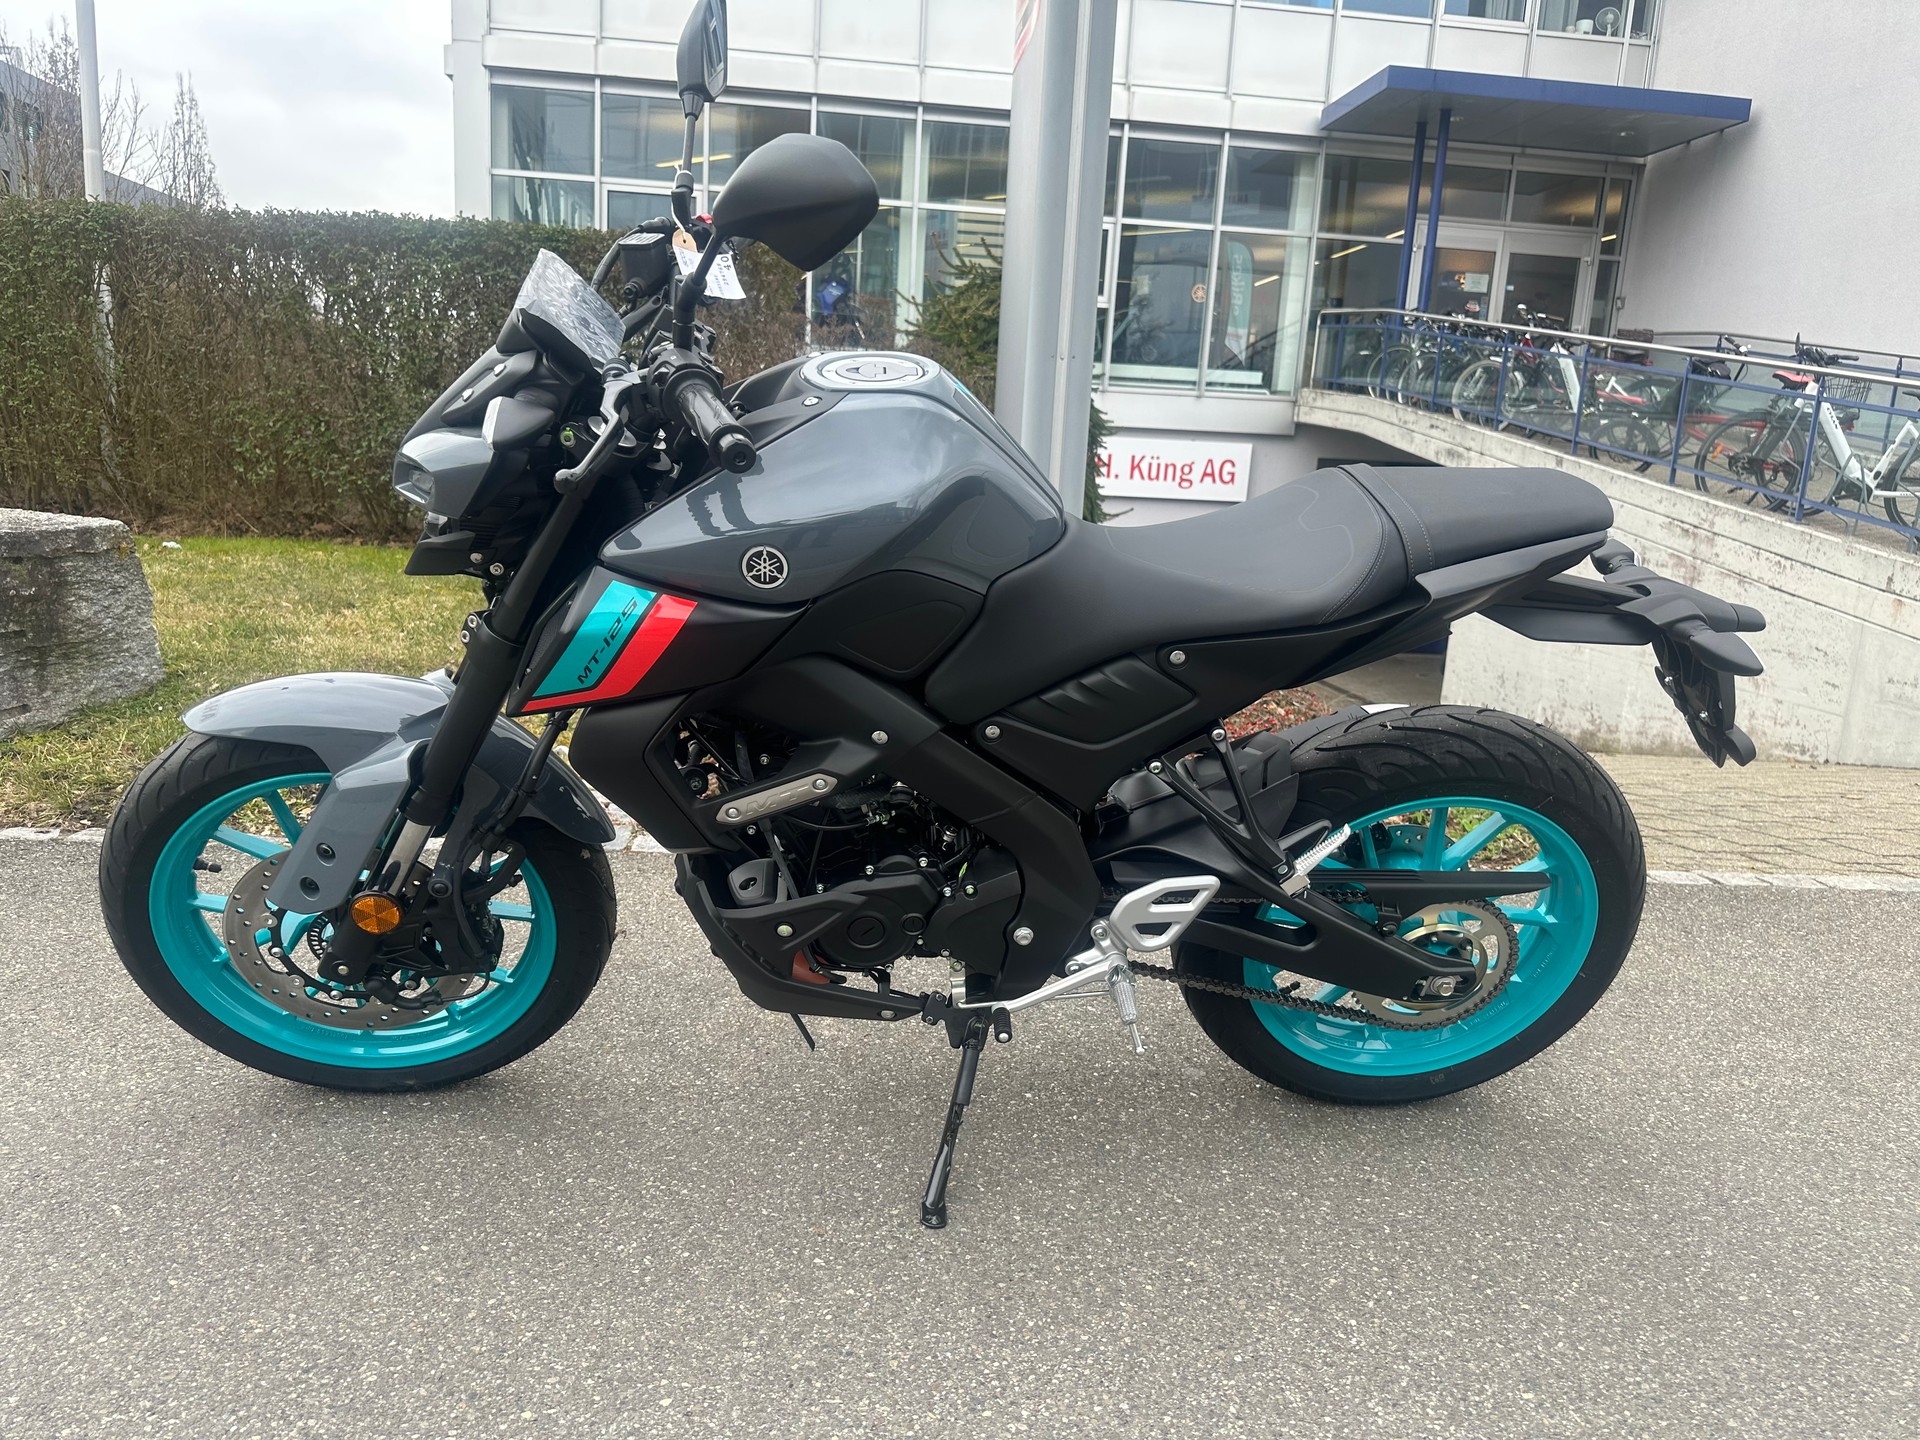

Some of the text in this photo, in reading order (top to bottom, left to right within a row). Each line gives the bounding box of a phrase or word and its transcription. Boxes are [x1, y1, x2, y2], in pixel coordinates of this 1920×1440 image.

[1094, 454, 1236, 489] H. Küng AG
[576, 597, 638, 685] MT-125
